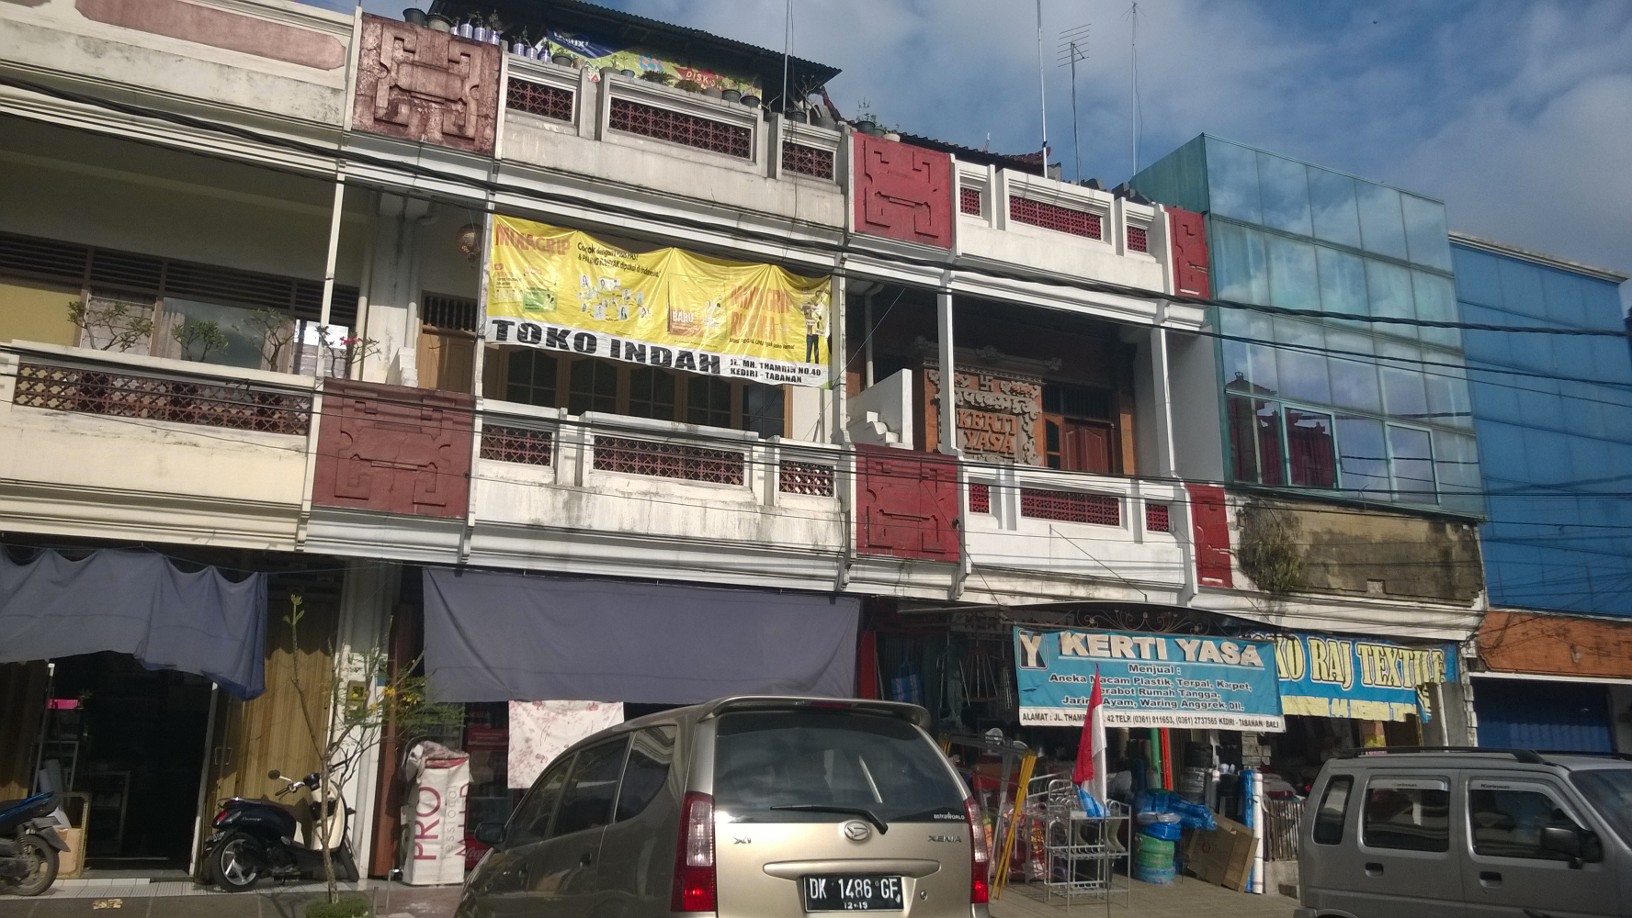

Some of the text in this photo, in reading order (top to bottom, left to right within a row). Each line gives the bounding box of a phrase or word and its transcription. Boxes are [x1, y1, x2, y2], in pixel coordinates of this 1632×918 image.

[672, 310, 694, 322] BARU
[492, 319, 721, 374] TOKO INDAH
[730, 368, 758, 377] KEDIRI
[765, 372, 802, 382] TABANAN
[759, 362, 796, 373] THAMRIN
[798, 367, 821, 376] NO.40
[958, 410, 1015, 436] KERTI
[964, 431, 1015, 455] YASA
[1020, 631, 1041, 667] Y
[1060, 631, 1264, 666] KERTI YASA
[1128, 664, 1174, 675] Menjual
[1308, 637, 1352, 690] RAJ
[1050, 674, 1087, 682] Aneka
[1134, 677, 1173, 687] Plastik,
[1177, 678, 1213, 688] Terpal,
[1092, 686, 1220, 699] erabot Rumah Tangga,
[1063, 697, 1090, 705] Jarin
[1103, 697, 1136, 707] Ayam,
[1140, 698, 1177, 708] Waring
[1181, 699, 1228, 710] Anggrek,
[1022, 712, 1048, 721] ALAMAT
[1107, 714, 1114, 722] 42
[1219, 718, 1235, 726] KEDIRI
[1239, 719, 1263, 727] TABANAN
[415, 786, 441, 860] PRO
[928, 835, 962, 843] XENIA
[809, 878, 898, 899] DK 1486 GF
